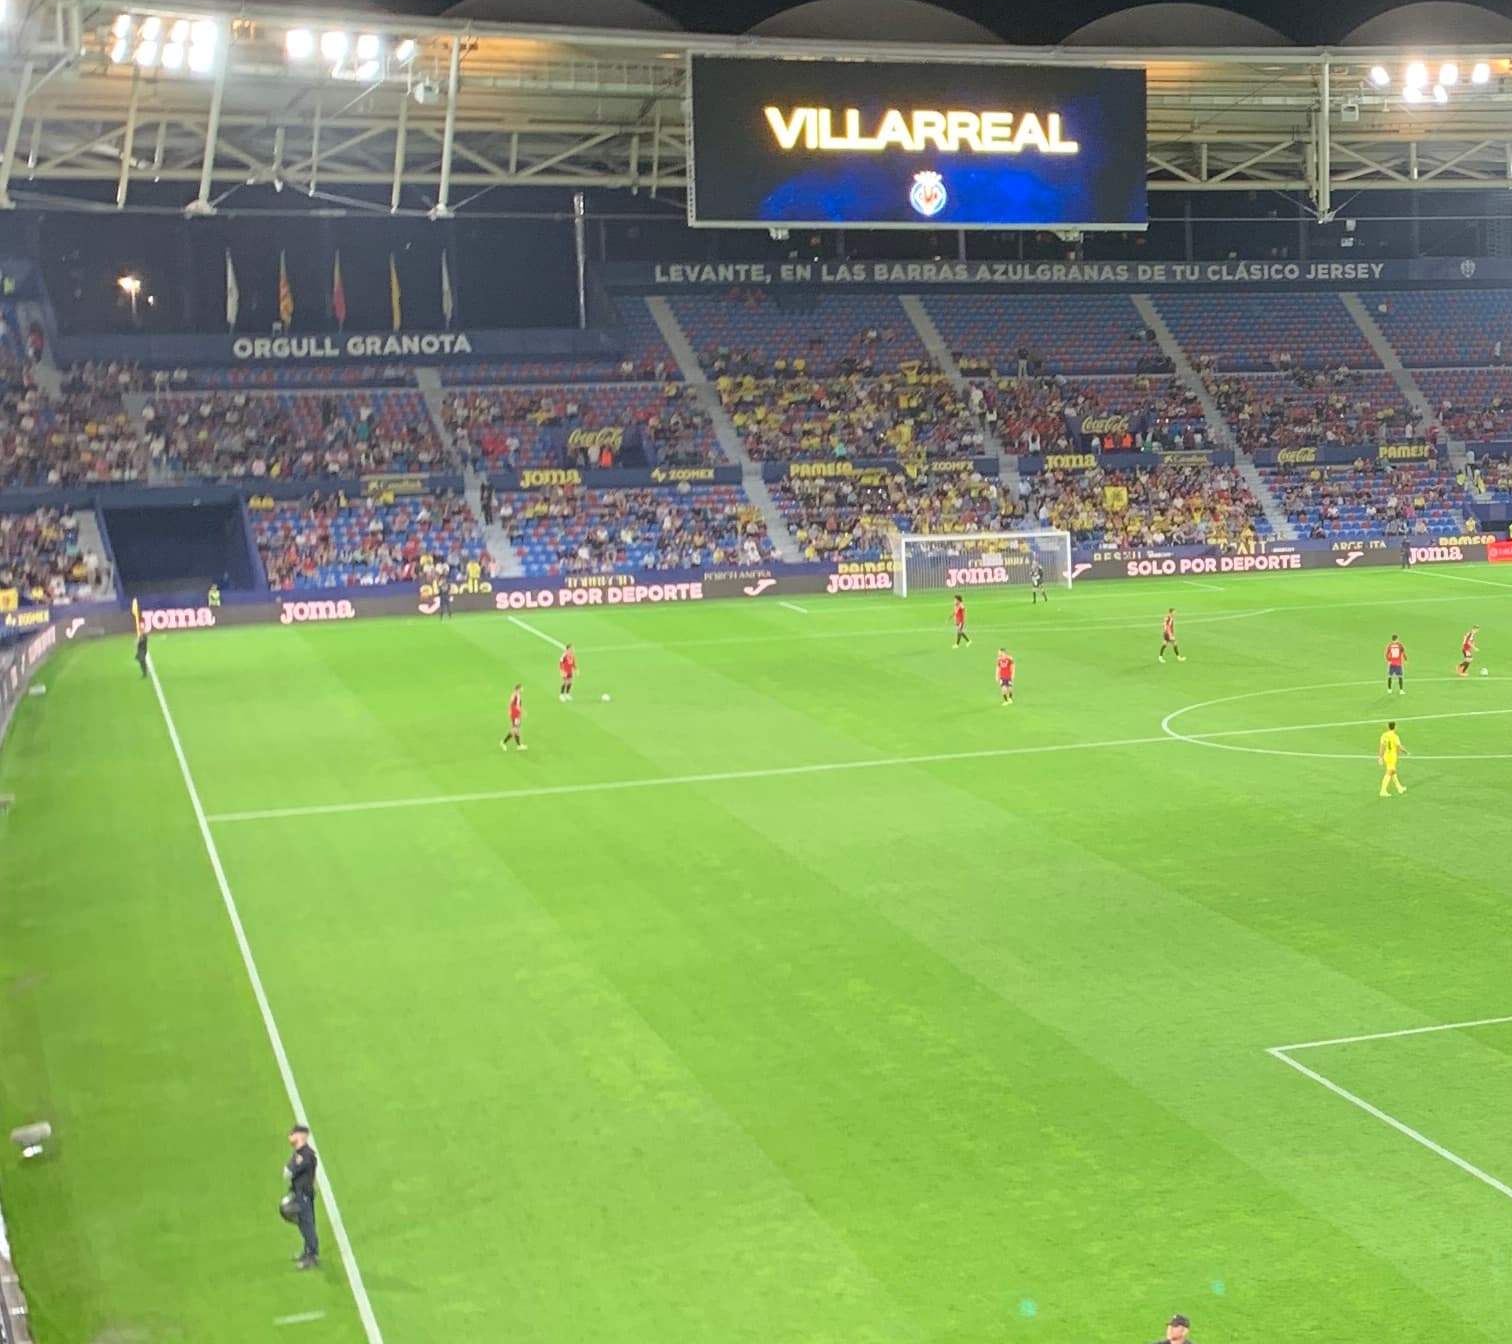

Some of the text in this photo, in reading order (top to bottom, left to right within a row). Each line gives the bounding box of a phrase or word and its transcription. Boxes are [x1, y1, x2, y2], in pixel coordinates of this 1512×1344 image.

[764, 105, 1079, 153] VILLARREAL
[655, 260, 1385, 284] LEVANTE, EN LAS BARRAS AZULGRANAS DE TU CLÁSICO JERSEY
[233, 333, 472, 358] ORGULL GRANOTA
[669, 467, 714, 482] ZOOMEX
[946, 567, 1008, 587] Joma
[1127, 554, 1302, 576] SOLO POR DEPORTE
[827, 573, 893, 593] Joma
[495, 582, 703, 609] SOLO POR DEPORTE
[140, 607, 215, 632] Joma
[280, 599, 355, 624] Joma
